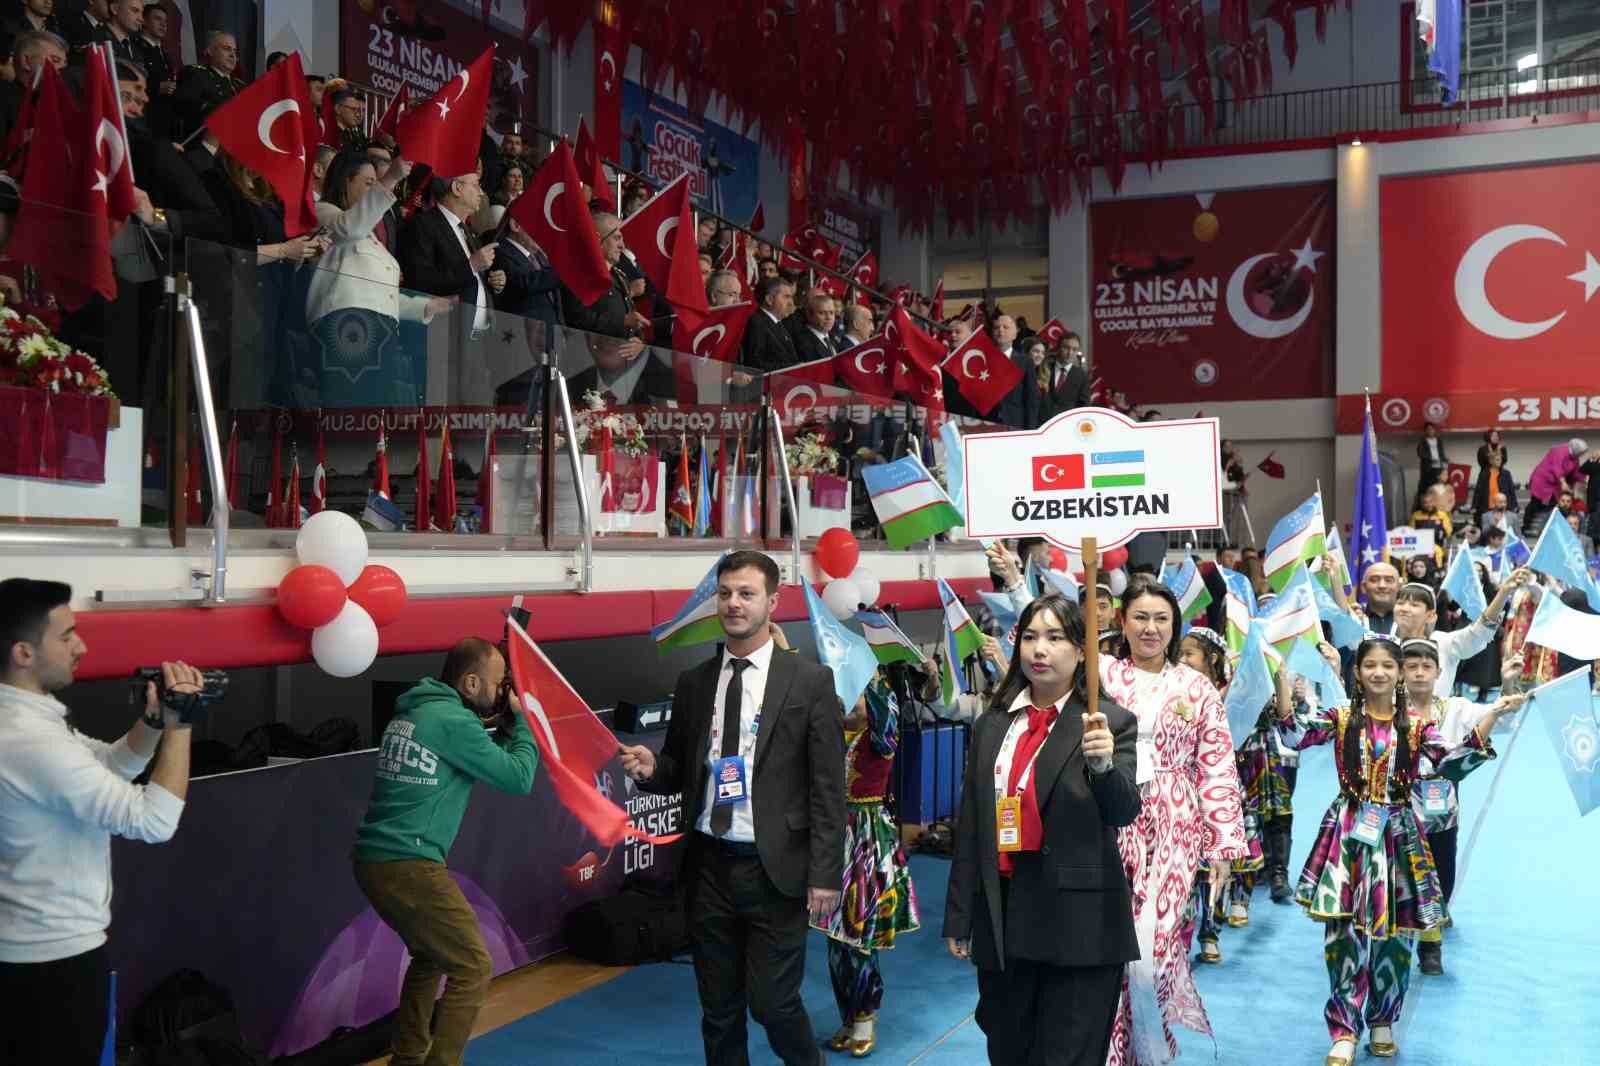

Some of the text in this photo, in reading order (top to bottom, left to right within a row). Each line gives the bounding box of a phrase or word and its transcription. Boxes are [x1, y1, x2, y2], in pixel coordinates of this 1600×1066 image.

[368, 23, 464, 82] 23 NİSAN
[1095, 276, 1219, 306] 23 NİSAN
[1095, 308, 1134, 318] ULUSAL
[1202, 302, 1216, 312] VE
[1100, 319, 1138, 332] ÇOCUK
[1498, 397, 1541, 422] 23
[1011, 492, 1170, 521] ÖZBEKİSTAN
[579, 864, 595, 882] TBF
